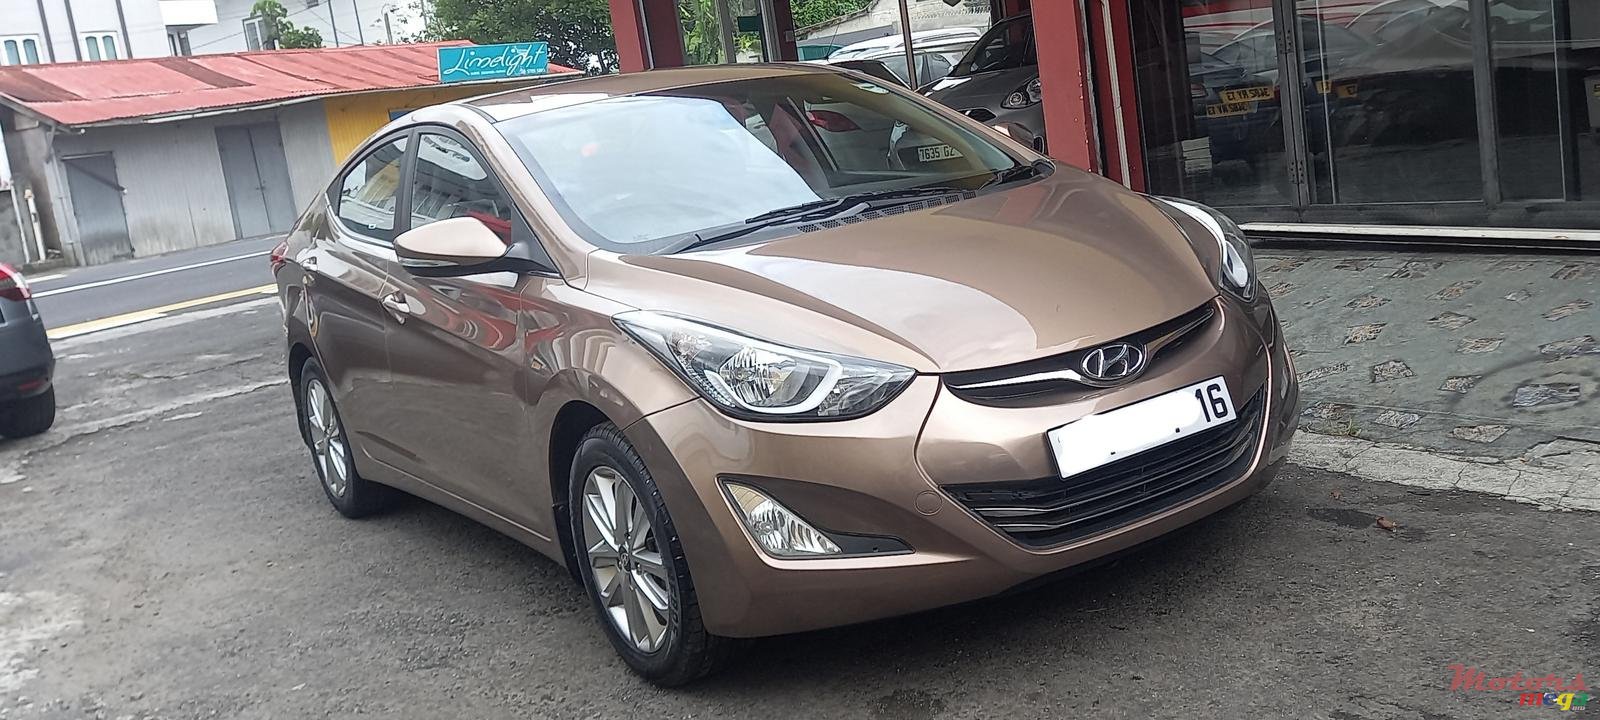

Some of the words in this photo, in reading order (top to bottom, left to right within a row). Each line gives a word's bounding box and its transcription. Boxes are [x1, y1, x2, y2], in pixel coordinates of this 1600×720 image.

[443, 43, 545, 76] Limelight
[920, 147, 940, 160] 7635
[1195, 383, 1228, 423] 16
